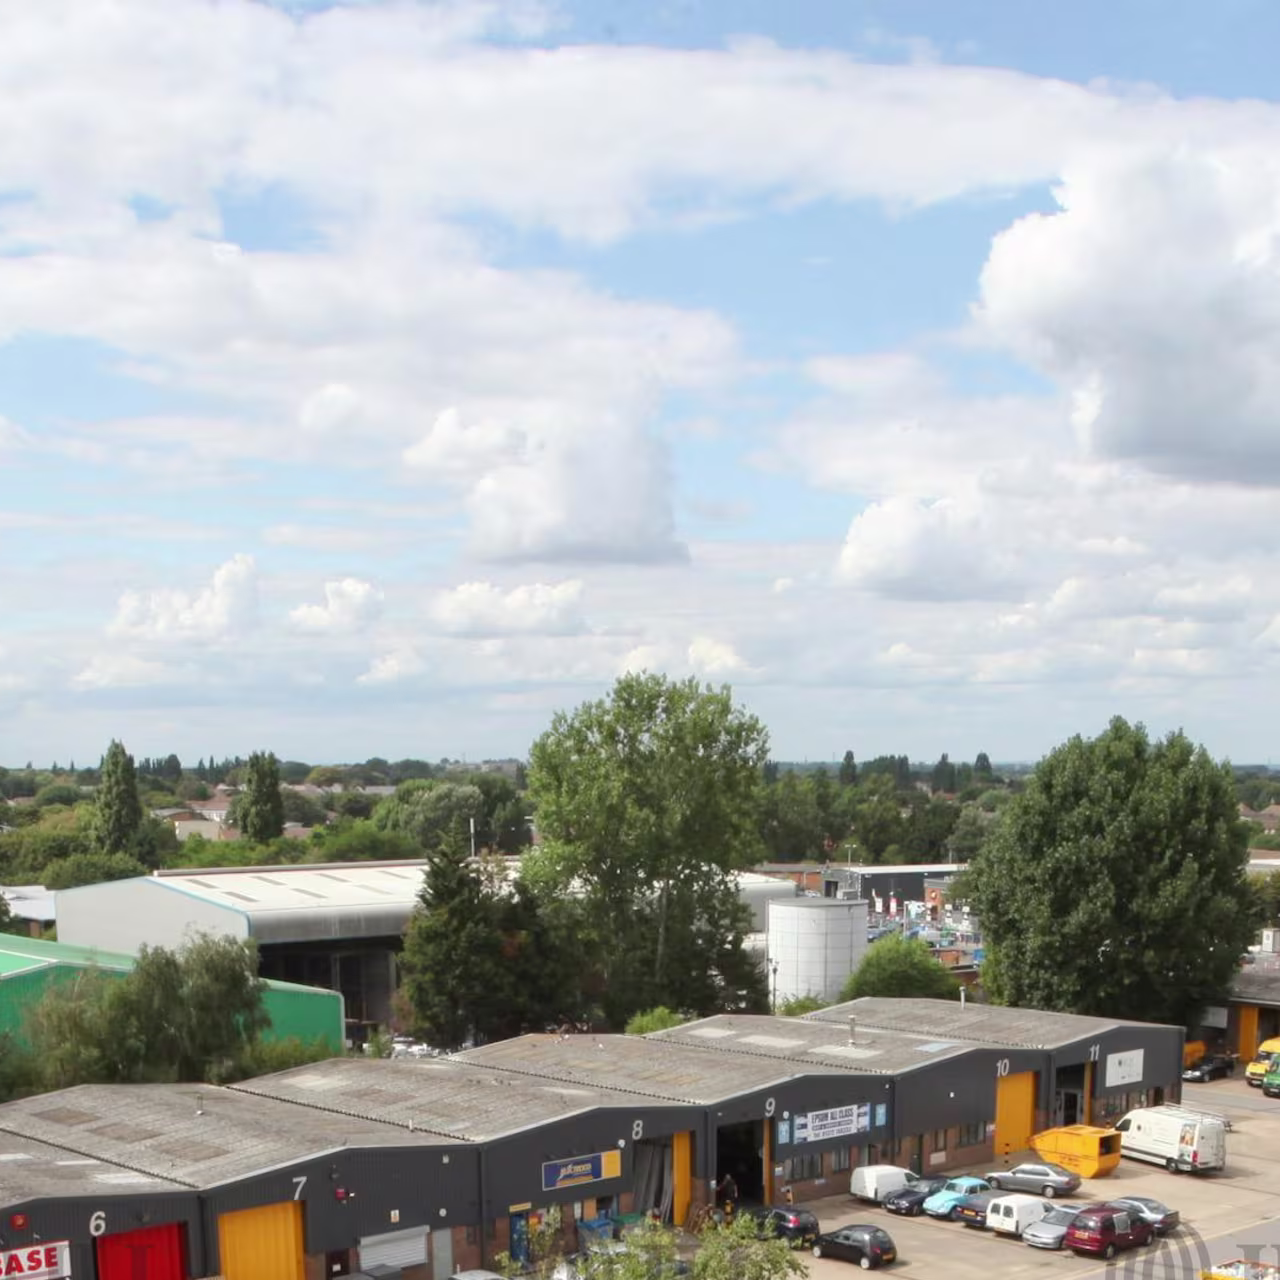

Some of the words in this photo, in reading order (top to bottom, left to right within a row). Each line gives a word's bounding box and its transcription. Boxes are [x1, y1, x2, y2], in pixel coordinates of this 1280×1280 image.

[1089, 1043, 1100, 1061] 11
[996, 1058, 1010, 1077] 10
[765, 1097, 776, 1118] 9
[632, 1119, 643, 1140] 8
[292, 1175, 308, 1201] 7
[89, 1211, 107, 1237] 6
